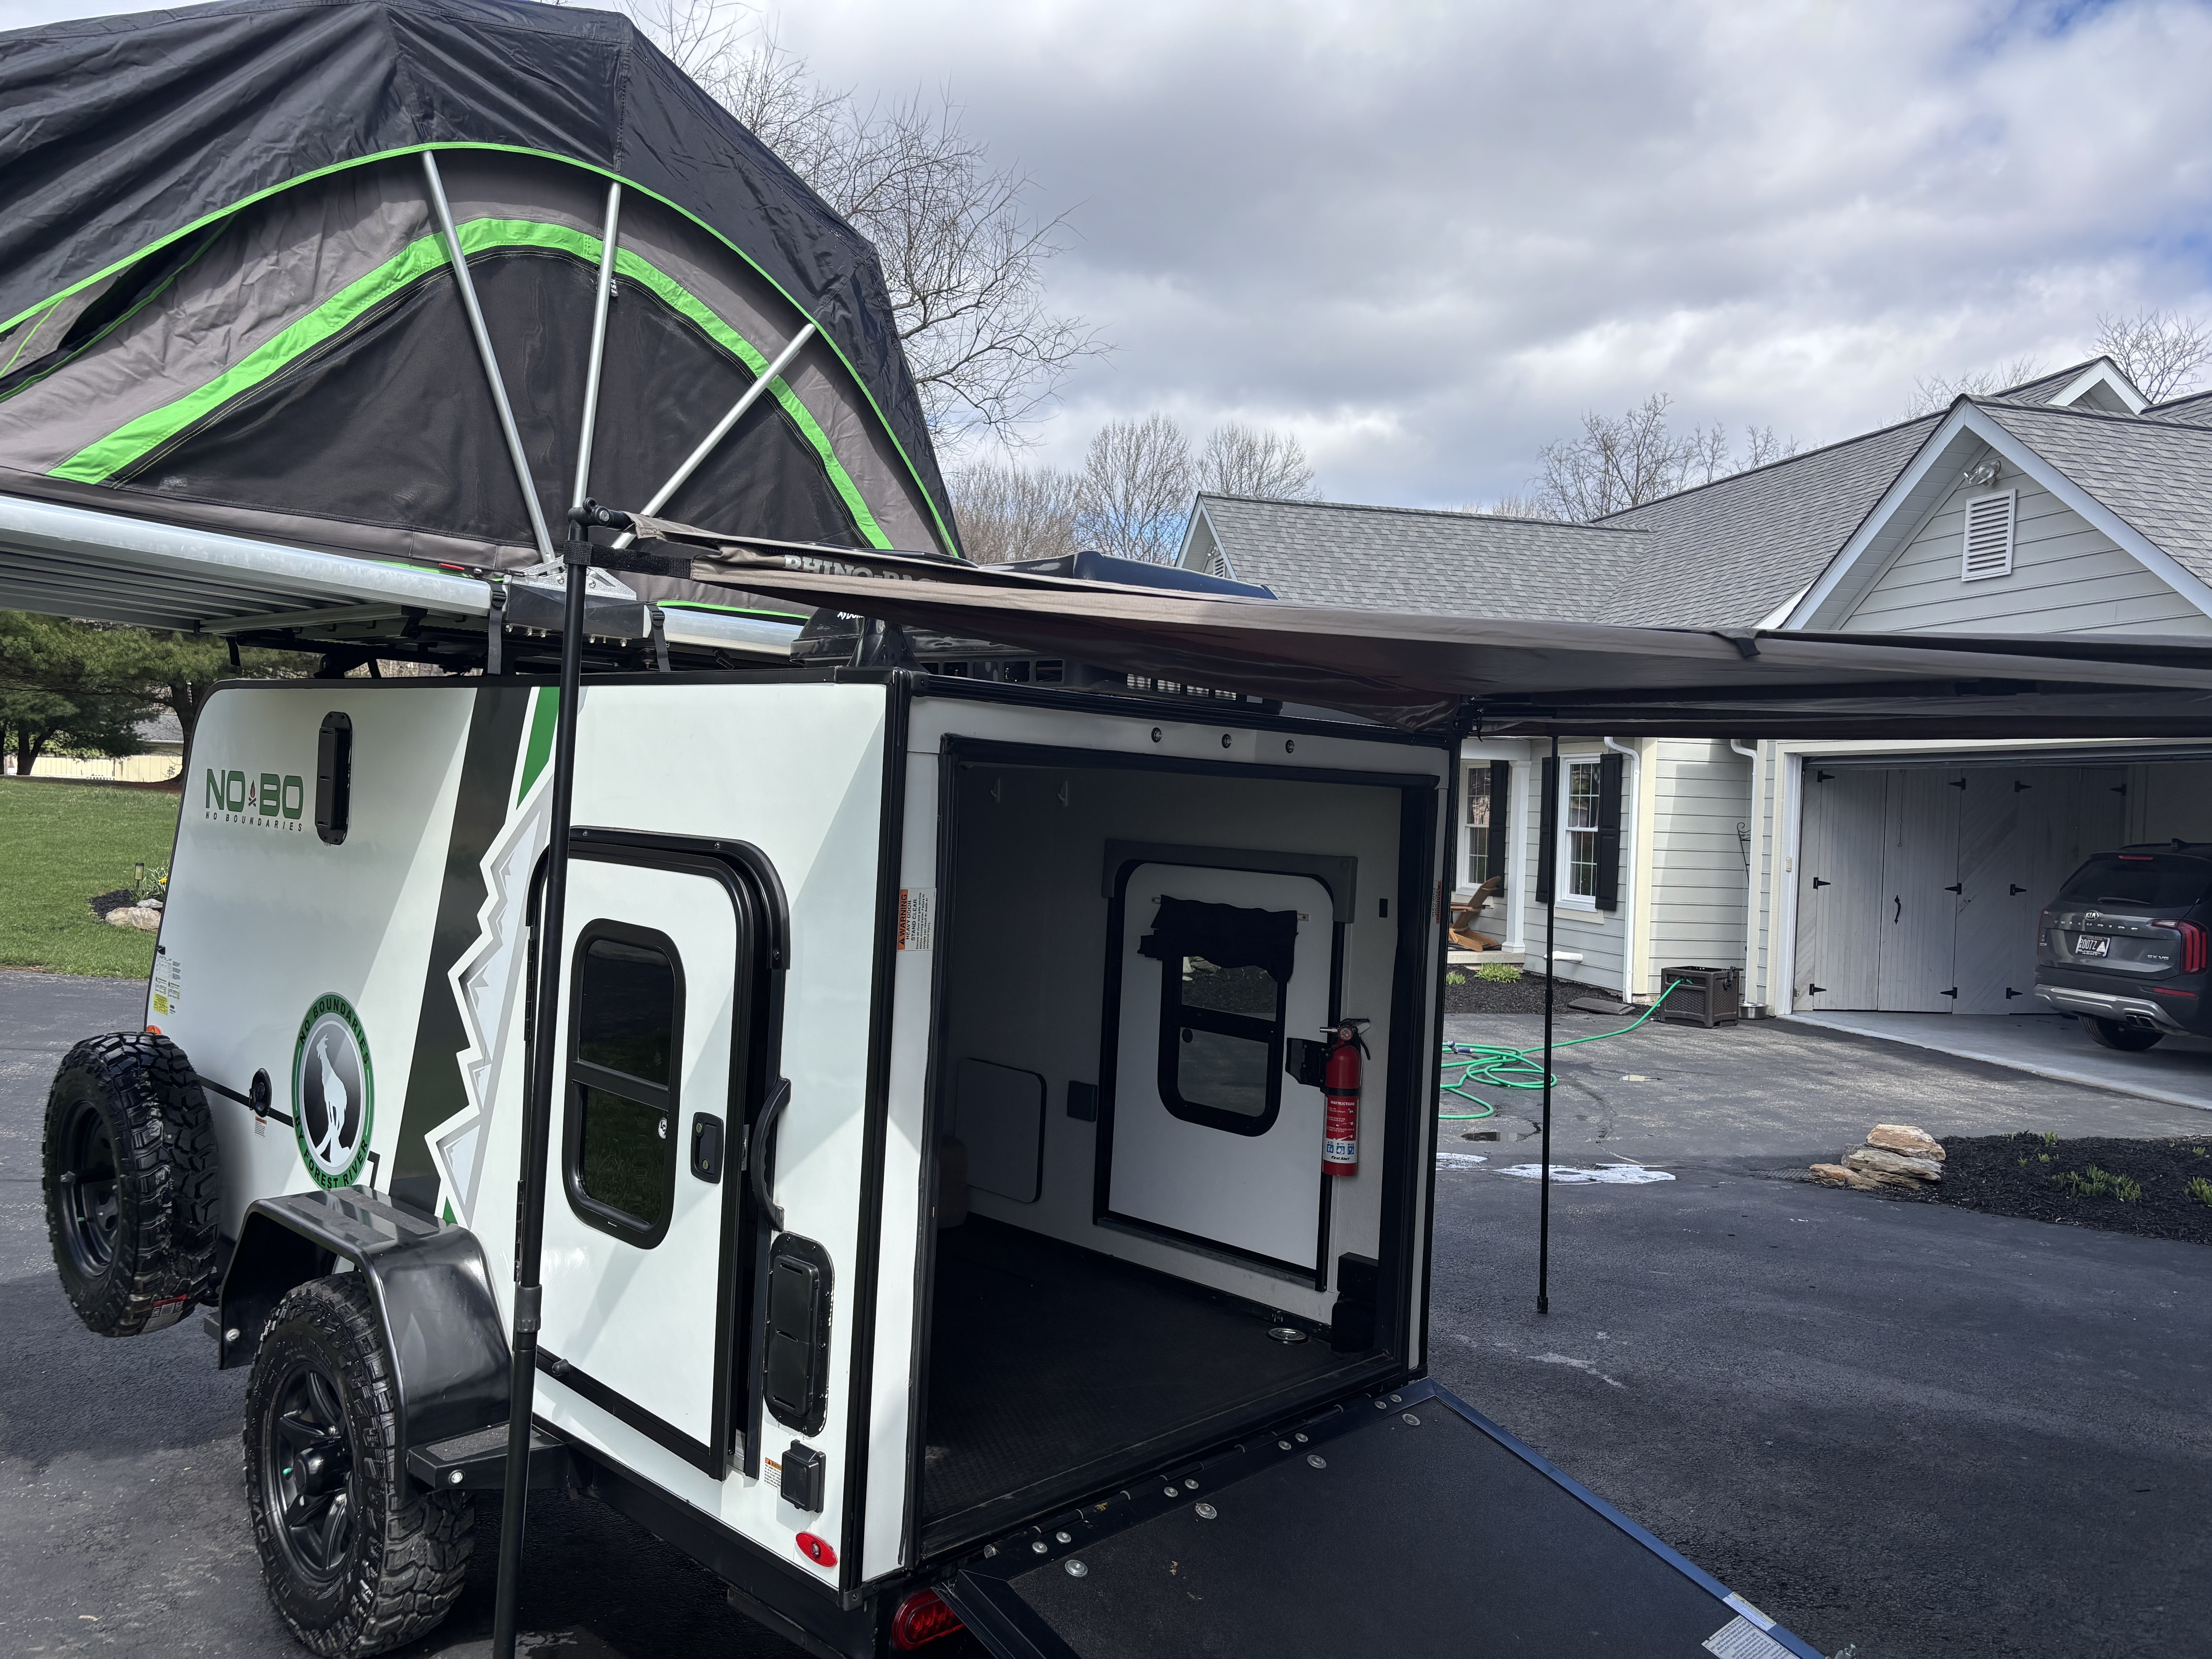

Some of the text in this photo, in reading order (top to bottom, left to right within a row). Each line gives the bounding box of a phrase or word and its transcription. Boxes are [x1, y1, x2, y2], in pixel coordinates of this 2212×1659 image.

[783, 555, 943, 582] RHINO-R
[206, 769, 304, 819] NO BO
[205, 811, 302, 832] NO BOUNDARIES
[899, 894, 907, 936] WARNING
[299, 998, 369, 1065] NO BOUNDARIES
[294, 1115, 304, 1140] BY
[304, 1151, 339, 1189] FOREST
[343, 1139, 368, 1187] RIVER
